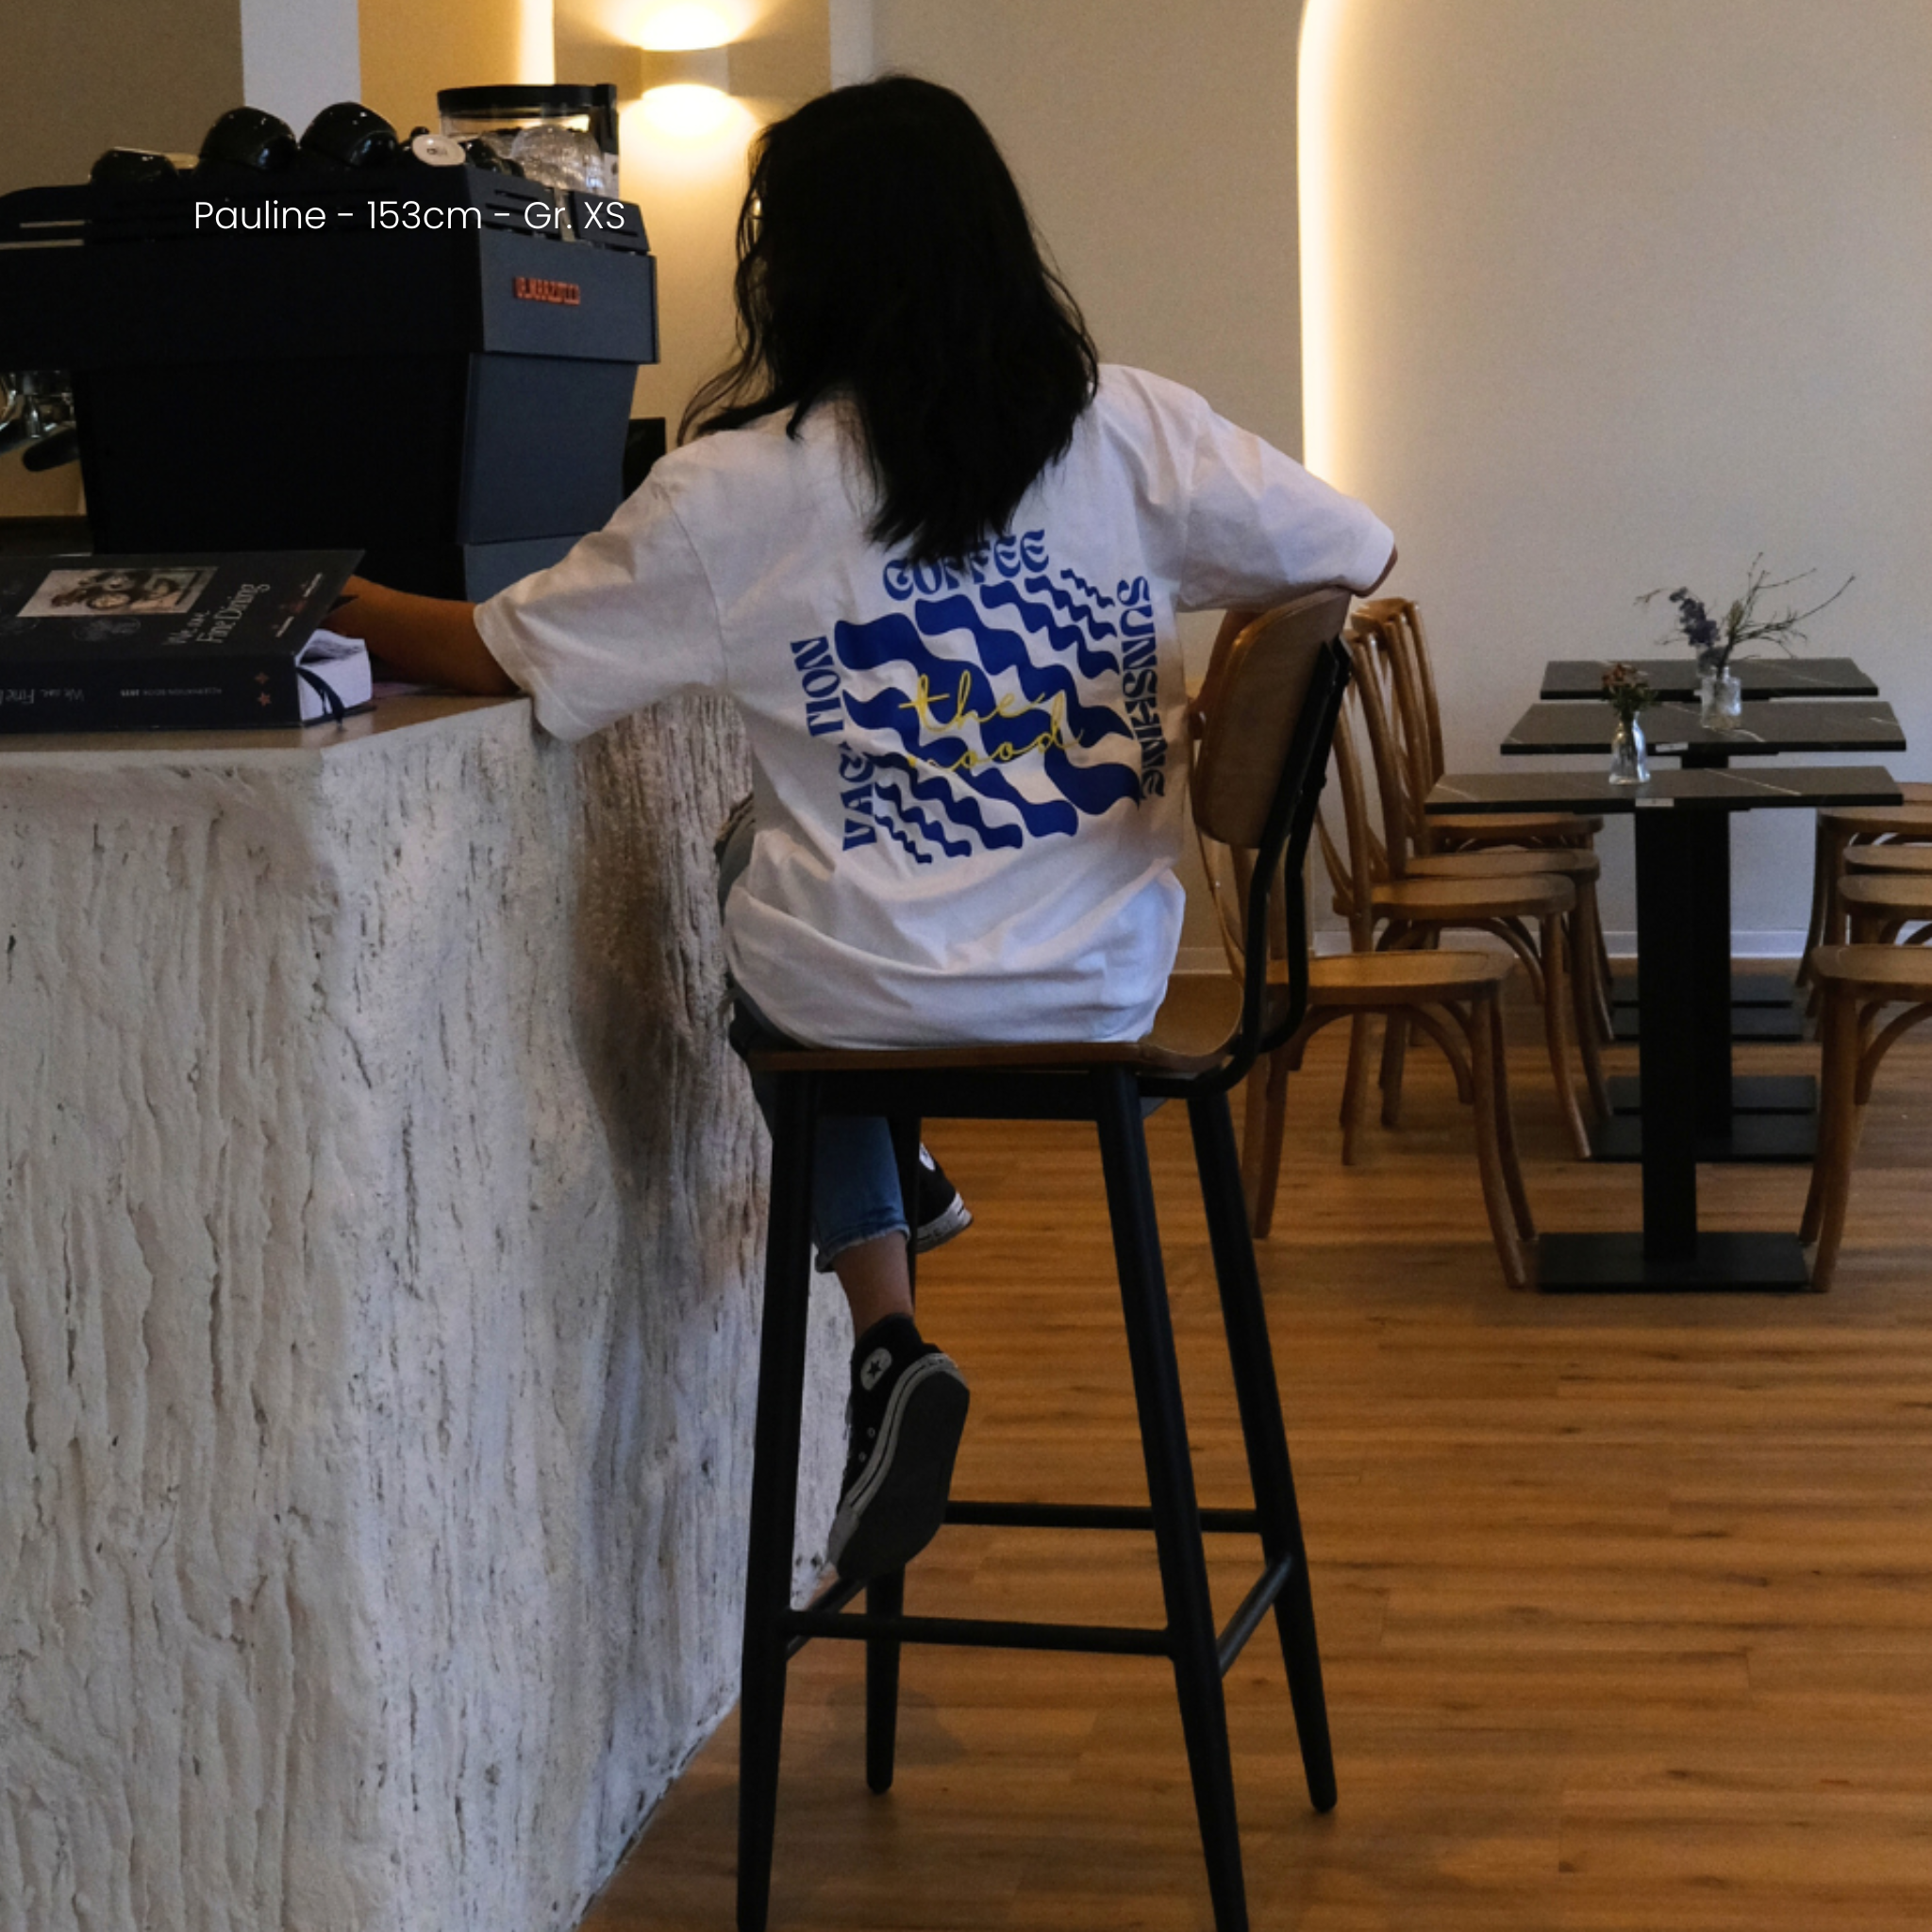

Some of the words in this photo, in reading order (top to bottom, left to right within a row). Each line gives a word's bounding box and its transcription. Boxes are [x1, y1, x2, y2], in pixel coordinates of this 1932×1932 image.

[196, 621, 237, 643] Fine
[213, 584, 271, 620] Dining
[898, 669, 1046, 732] the
[1116, 575, 1169, 798] SUNSHINE
[790, 635, 878, 851] VACTION
[907, 689, 1086, 773] ood
